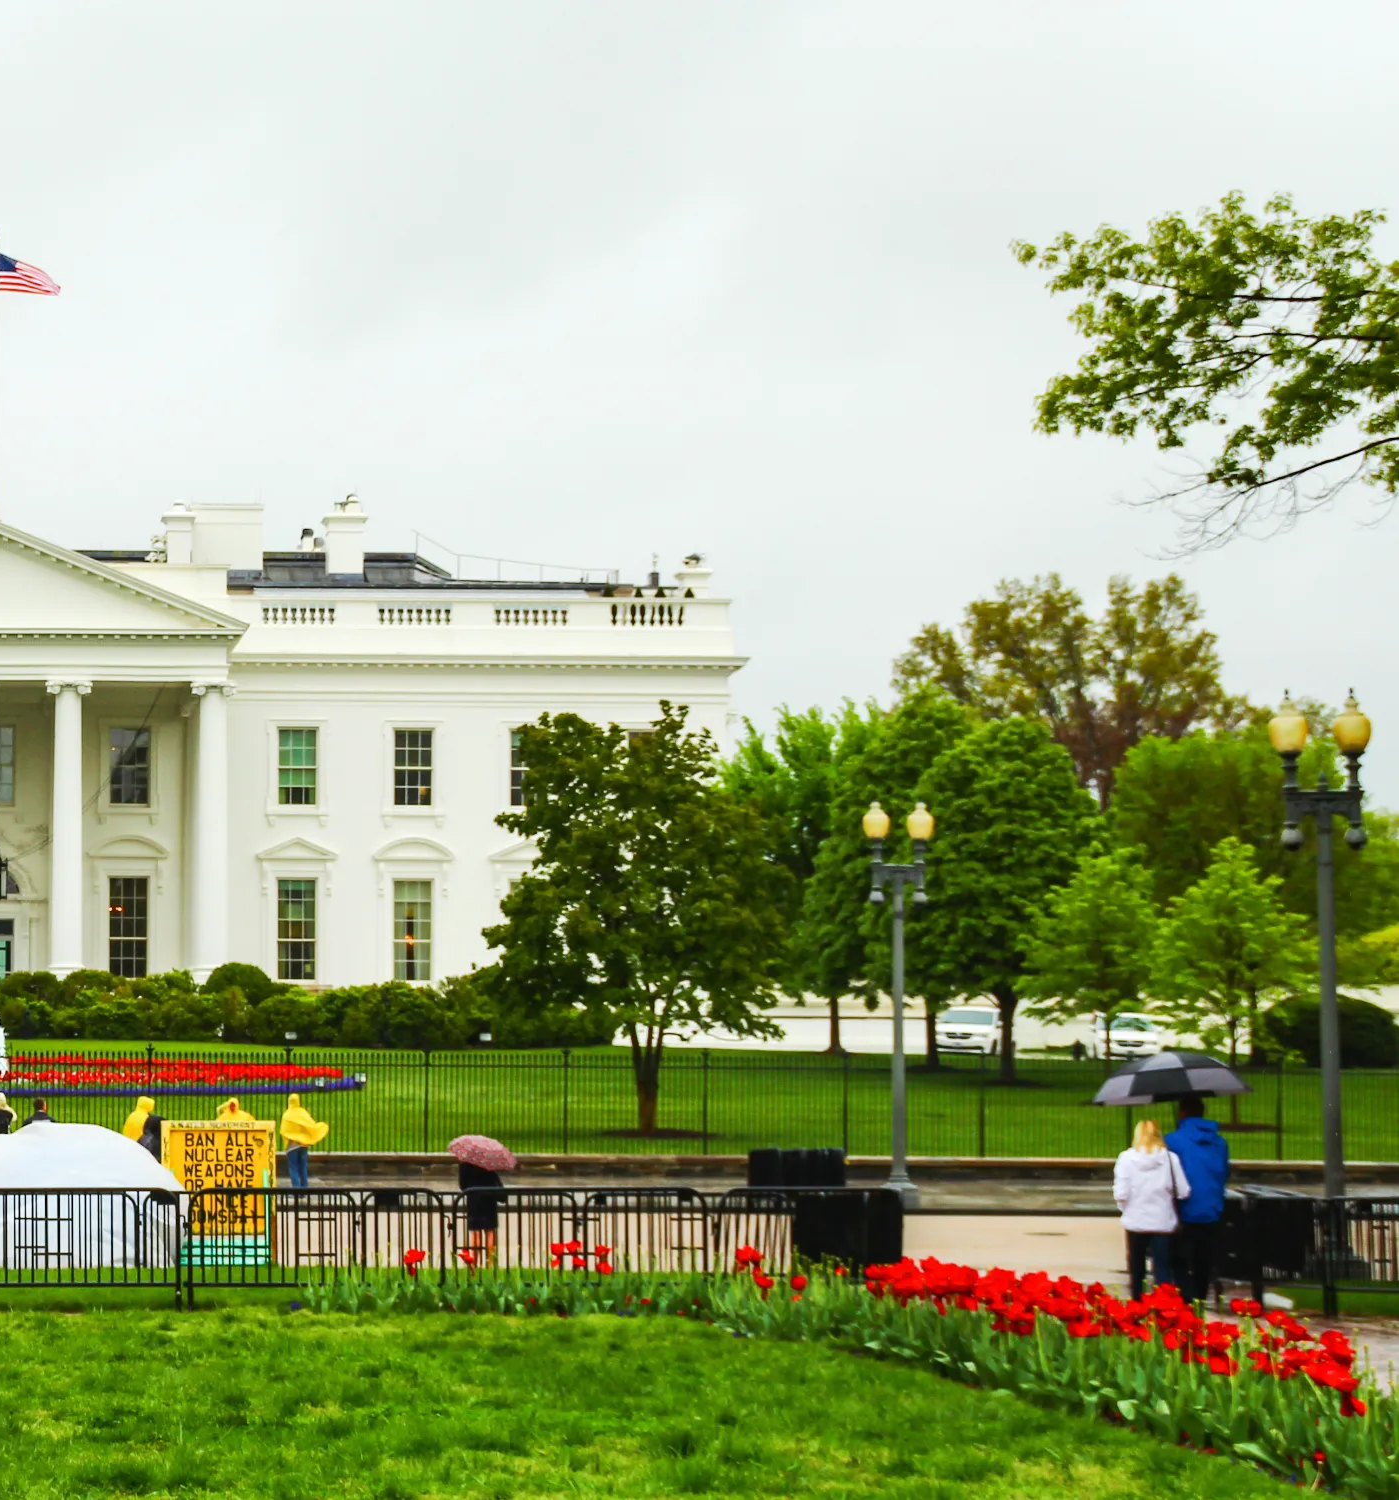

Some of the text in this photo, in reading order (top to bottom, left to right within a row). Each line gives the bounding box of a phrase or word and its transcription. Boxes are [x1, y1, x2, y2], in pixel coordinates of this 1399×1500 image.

[185, 1132, 254, 1147] BAN ALL
[184, 1148, 254, 1163] NUCLEAR
[183, 1163, 254, 1178] WEAPONS
[184, 1178, 204, 1192] OR
